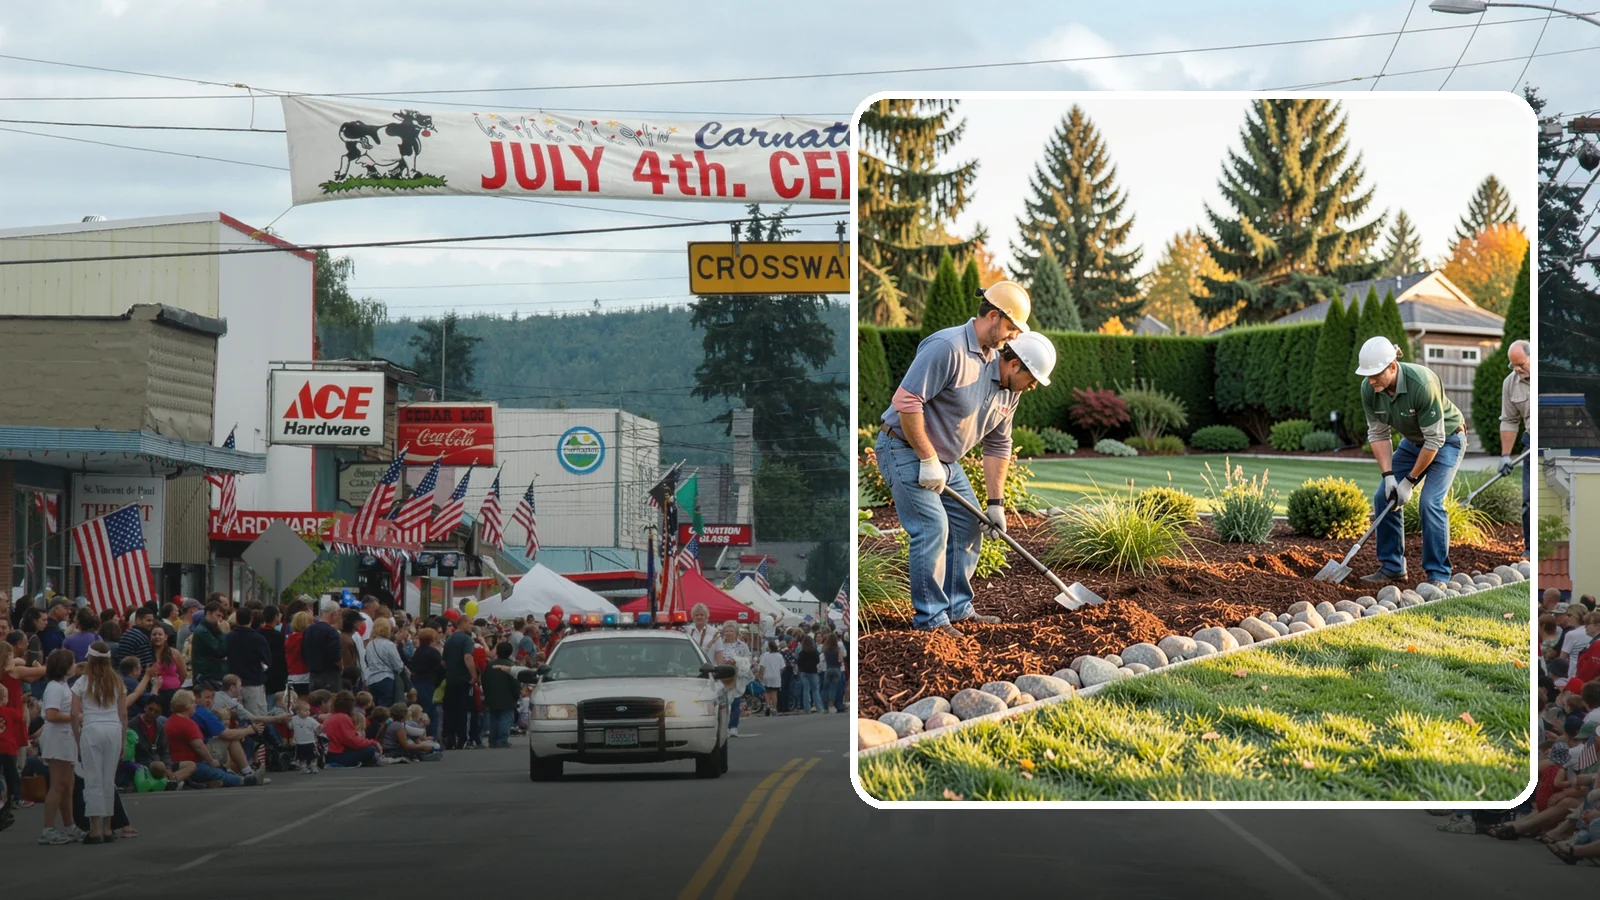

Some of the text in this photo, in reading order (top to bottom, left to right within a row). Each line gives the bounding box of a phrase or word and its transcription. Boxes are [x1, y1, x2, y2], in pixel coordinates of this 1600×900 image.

[481, 141, 604, 192] JULY
[632, 150, 746, 197] 4th.
[697, 254, 850, 279] CROSSWA
[282, 379, 373, 420] ACE
[405, 409, 485, 422] CEDAR LOG
[283, 421, 370, 436] Hardware
[416, 428, 476, 447] Coca-Cola
[353, 467, 385, 481] Simpl
[95, 485, 125, 495] Vincent
[126, 486, 136, 495] de
[137, 486, 155, 495] Paul
[688, 526, 741, 535] CRNATION
[699, 535, 730, 543] GLASS
